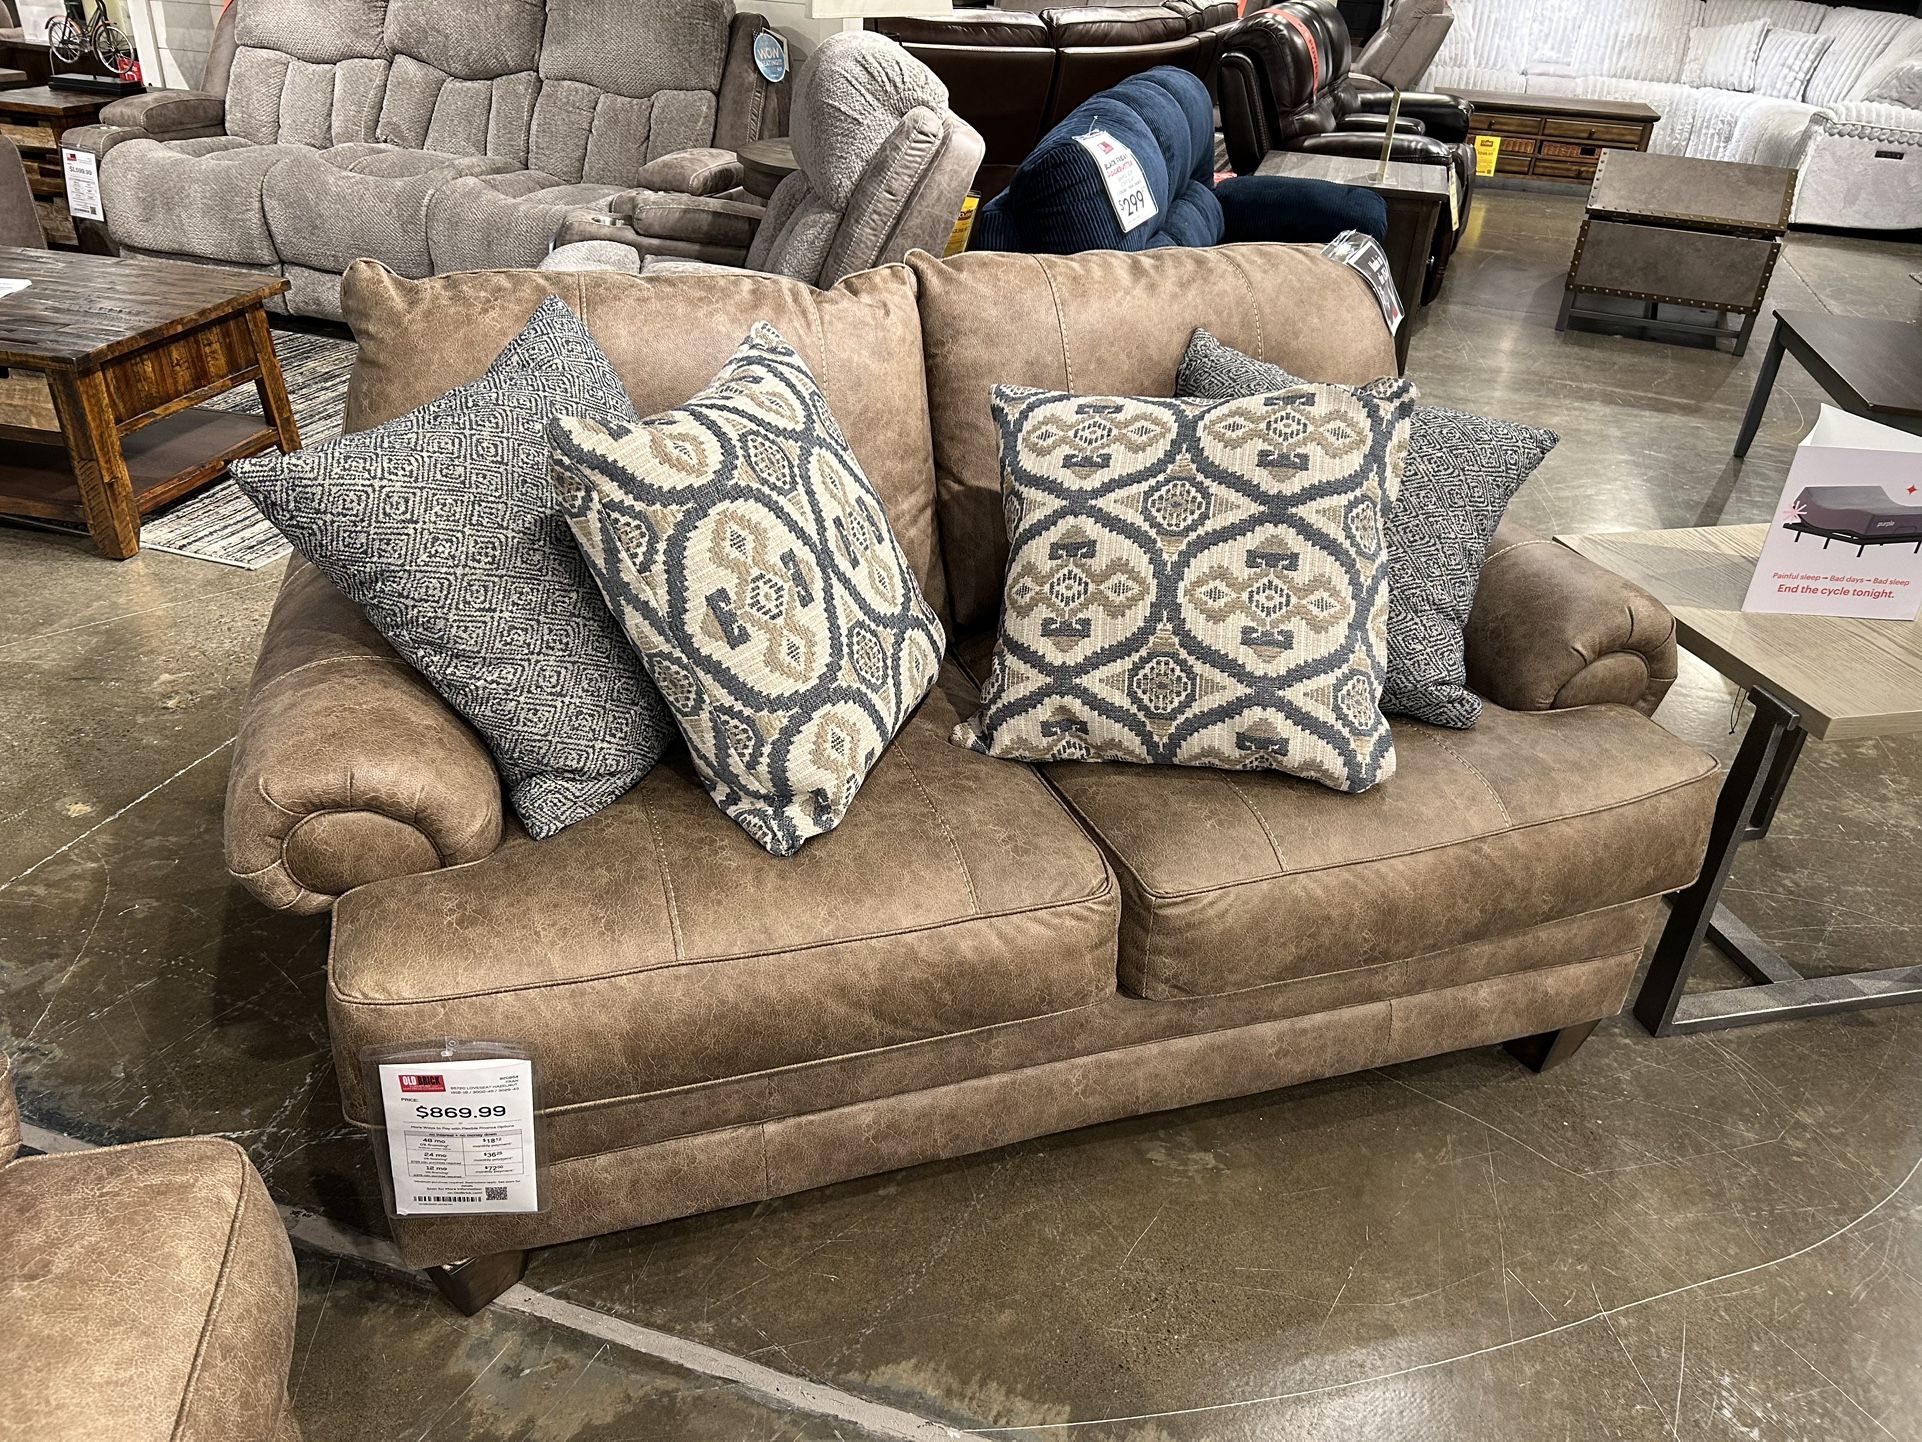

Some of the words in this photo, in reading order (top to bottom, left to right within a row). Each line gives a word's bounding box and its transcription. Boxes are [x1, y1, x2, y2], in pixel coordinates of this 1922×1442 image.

[1876, 520, 1895, 528] purple
[1772, 572, 1799, 580] Painful
[1846, 576, 1864, 584] days
[1890, 578, 1910, 586] sleep
[1777, 584, 1799, 594] End
[1800, 584, 1819, 594] the
[1821, 587, 1850, 597] cycle
[1852, 588, 1895, 599] tonight.
[402, 1075, 416, 1086] OLD
[417, 1075, 440, 1086] BRICK
[416, 1105, 506, 1119] $869.99
